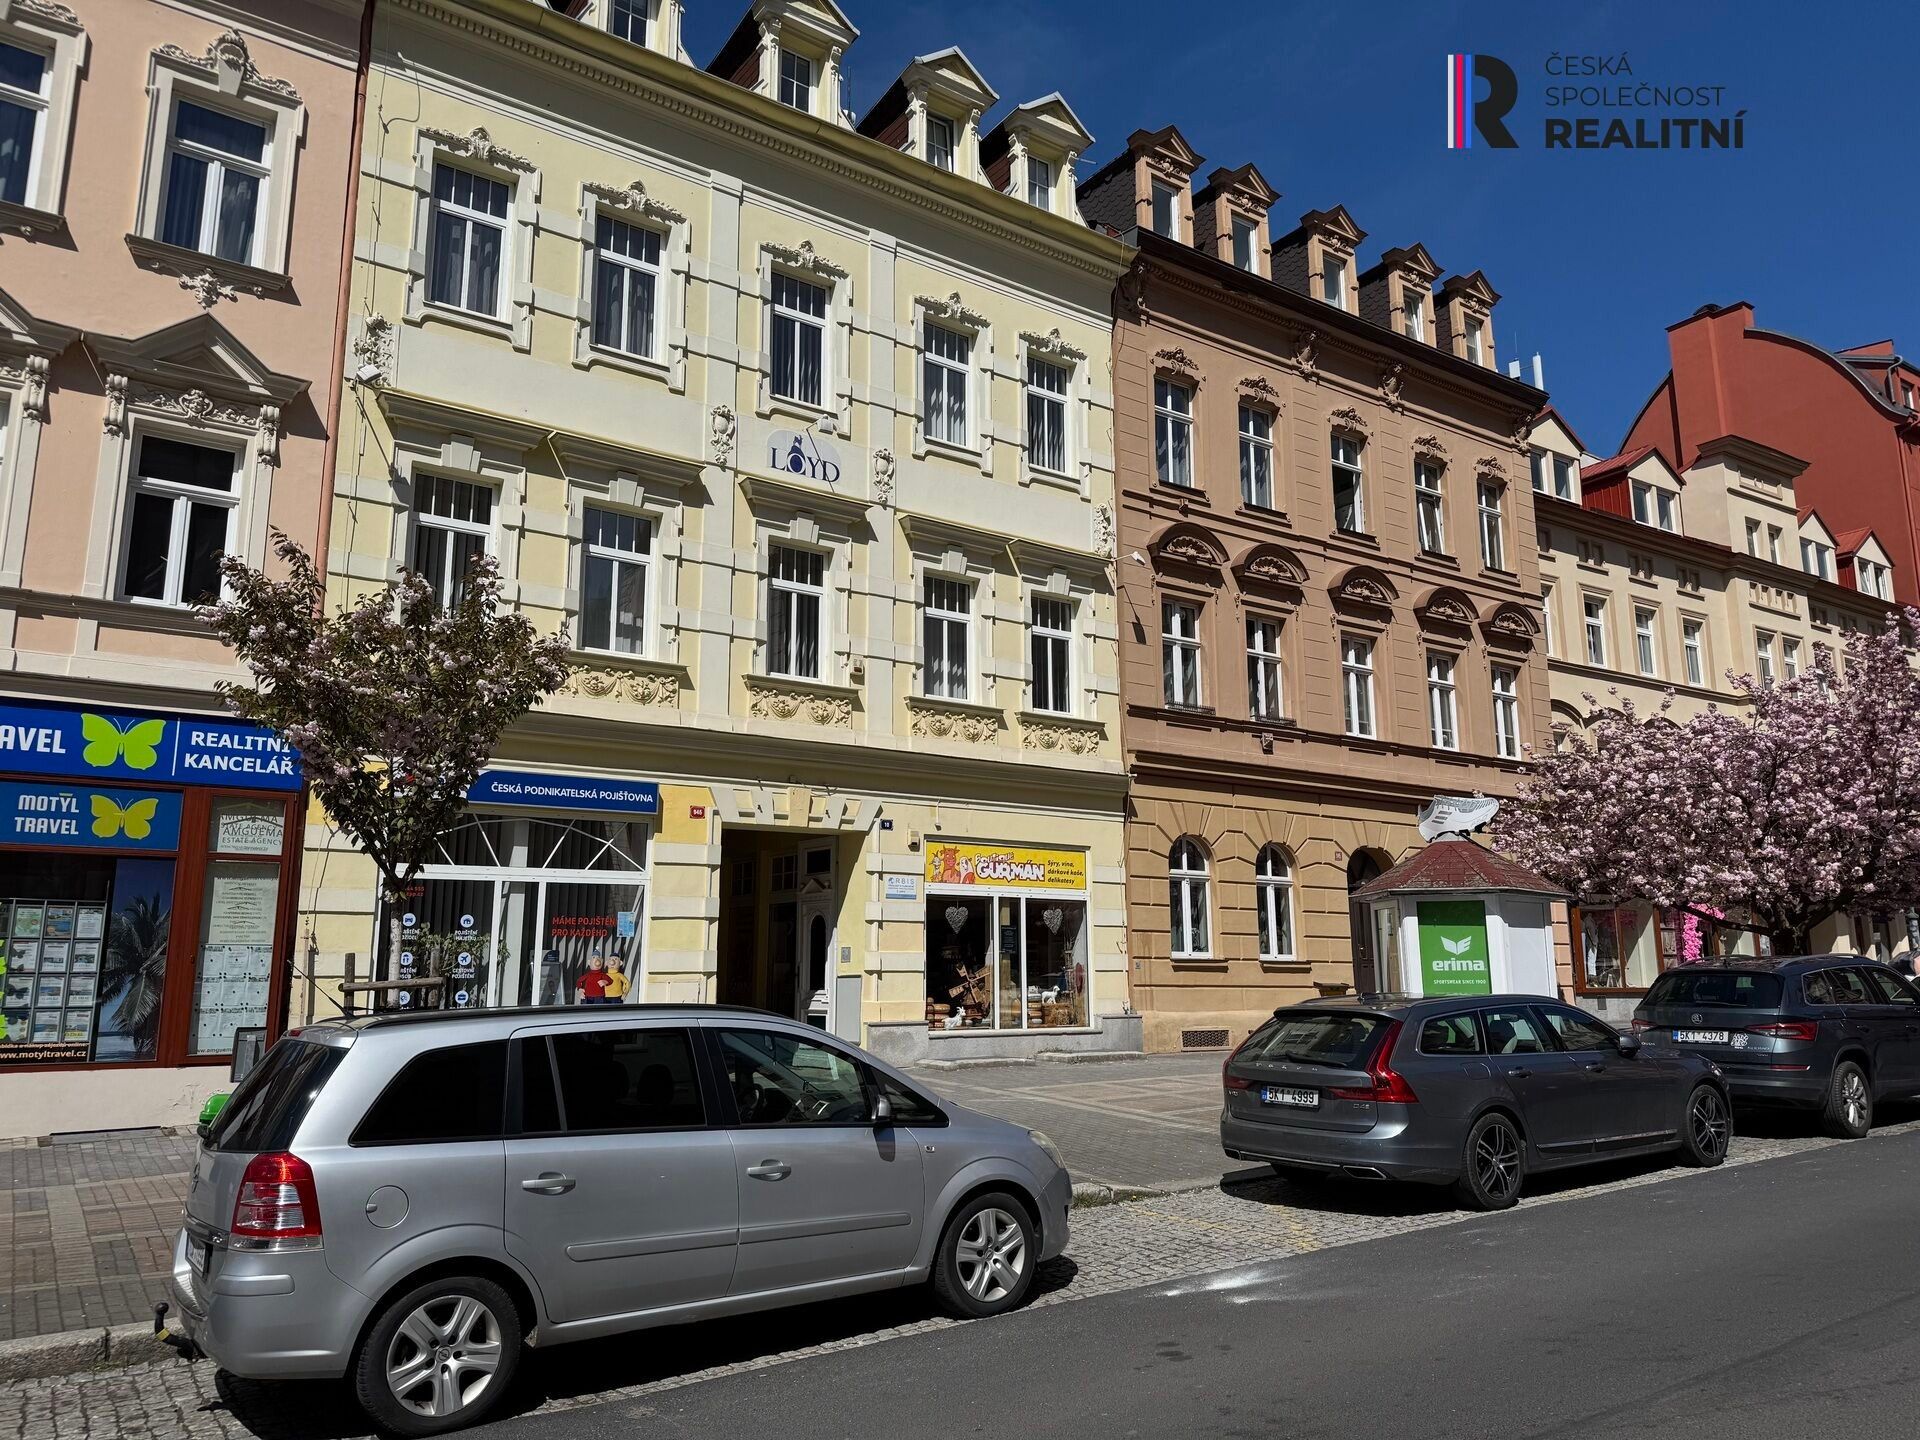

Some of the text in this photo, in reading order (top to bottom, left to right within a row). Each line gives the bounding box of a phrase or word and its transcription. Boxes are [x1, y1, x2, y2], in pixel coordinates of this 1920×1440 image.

[771, 446, 841, 483] LOYD
[184, 753, 294, 776] KANCELÁŘ
[491, 782, 654, 803] ČESKÁ PODNIKATELSKÁ POJIŠŤOVNA
[14, 817, 80, 835] TRAVEL
[976, 860, 1045, 883] GURMÁN
[552, 915, 577, 925] MÁME
[577, 915, 616, 926] POJIŠTĚN
[551, 928, 568, 937] PRO
[1432, 957, 1485, 971] erima
[1680, 1031, 1696, 1040] 5K1
[1702, 1031, 1725, 1041] 4378
[1268, 1087, 1315, 1104] 5K1 4999
